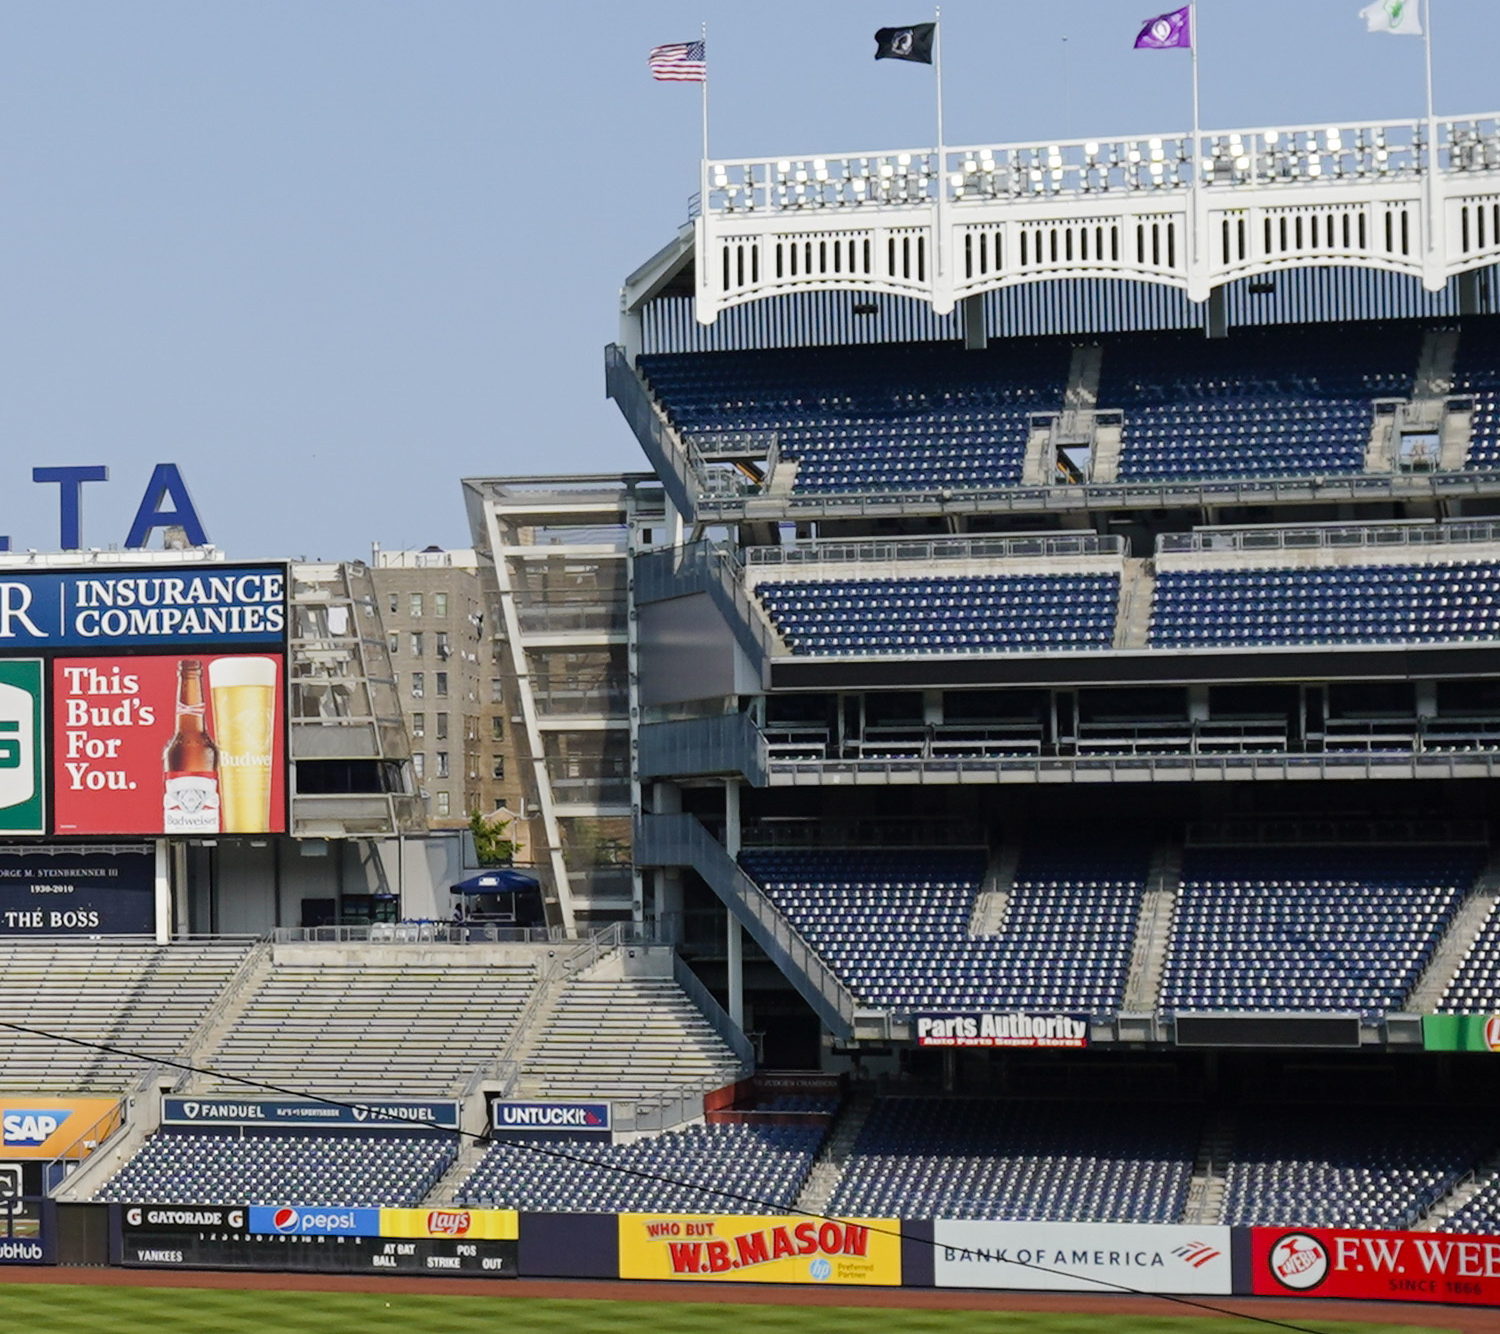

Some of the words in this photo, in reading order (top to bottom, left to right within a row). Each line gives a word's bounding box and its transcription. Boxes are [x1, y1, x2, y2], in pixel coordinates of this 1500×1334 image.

[75, 574, 284, 608] INSURANCE
[75, 602, 283, 637] COMPANIES
[64, 667, 139, 695] This
[65, 698, 155, 727] Bud’s
[66, 731, 121, 758] For
[64, 762, 137, 790] You.
[24, 868, 34, 878] M.
[37, 868, 107, 878] STEINBRENNER
[108, 868, 119, 877] III
[30, 884, 74, 894] 1930-2010
[5, 911, 44, 928] THE
[50, 910, 100, 928] BOSS
[918, 1017, 977, 1038] Parts
[980, 1012, 1086, 1039] Authority
[923, 1037, 955, 1046] Auto
[957, 1037, 993, 1046] Parts
[995, 1038, 1036, 1046] Super
[1038, 1038, 1082, 1047] Stores
[201, 1105, 265, 1119] FANDUEL
[371, 1107, 436, 1121] FANDUEL
[3, 1115, 57, 1141] SAP
[147, 1210, 222, 1226] GATORADE
[302, 1213, 356, 1231] pepsi
[647, 1223, 680, 1239] WHO
[685, 1222, 714, 1237] BUT
[137, 1249, 183, 1264] YANKEES
[384, 1244, 396, 1255] AT
[398, 1244, 416, 1255] BAT
[457, 1245, 477, 1256] POS
[944, 1247, 1007, 1263] BANK
[1017, 1249, 1046, 1265] OF
[1053, 1250, 1166, 1267] AMERICA
[1334, 1237, 1405, 1274] F.W.
[373, 1255, 397, 1267] BALL
[427, 1257, 461, 1269] STRIKE
[482, 1258, 502, 1270] OUT
[1281, 1249, 1317, 1276] WEBB
[1389, 1279, 1437, 1294] SINCE
[1446, 1281, 1483, 1296] 1866
